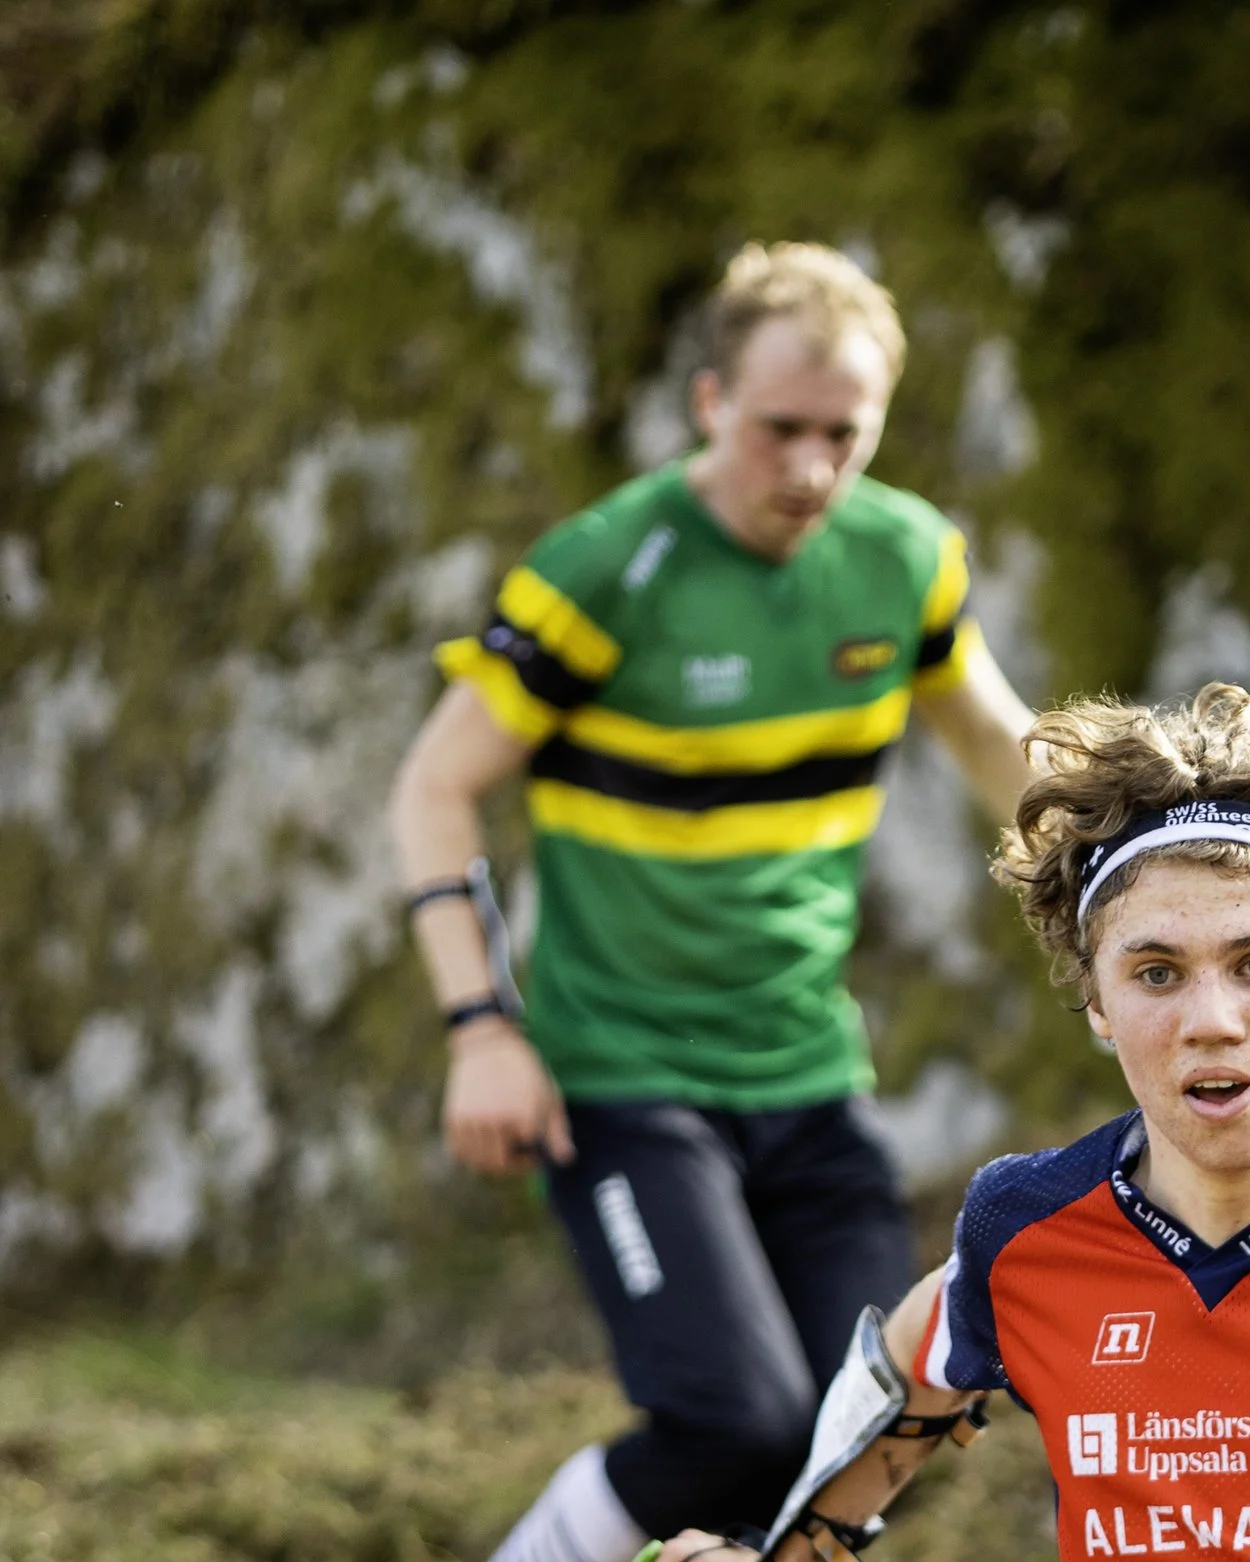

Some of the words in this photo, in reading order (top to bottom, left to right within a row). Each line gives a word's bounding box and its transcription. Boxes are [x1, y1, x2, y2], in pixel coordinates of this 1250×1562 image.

[1166, 801, 1218, 819] swiss
[1134, 1202, 1192, 1257] Linné
[1127, 1444, 1248, 1481] Uppsala
